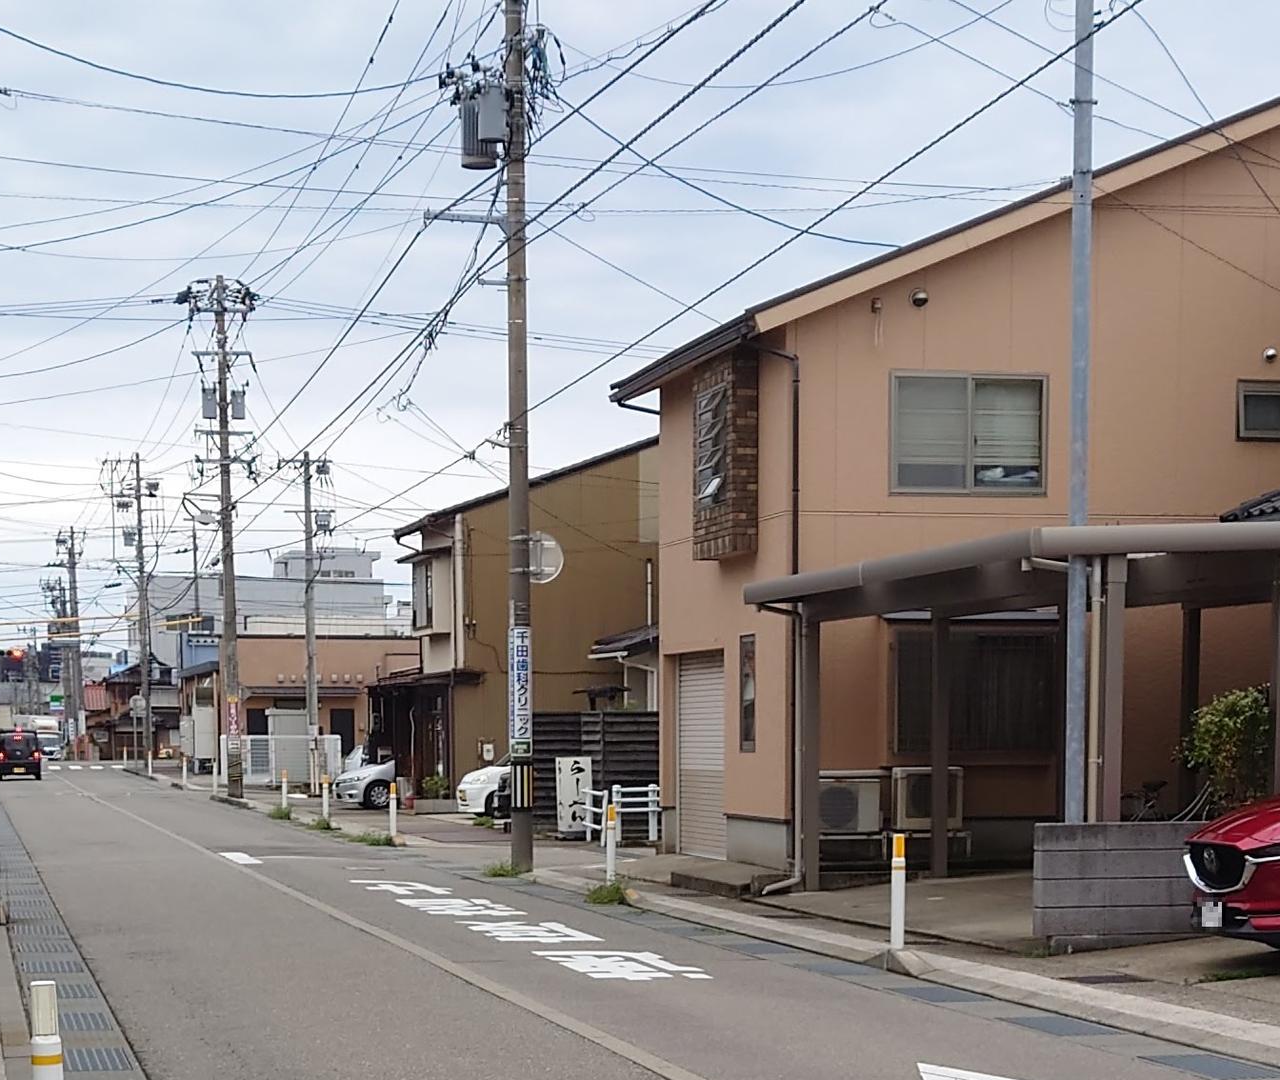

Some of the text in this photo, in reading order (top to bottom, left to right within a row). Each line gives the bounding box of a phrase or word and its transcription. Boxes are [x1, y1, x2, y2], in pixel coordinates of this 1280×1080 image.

[516, 631, 528, 736] 千田歯科クリニック
